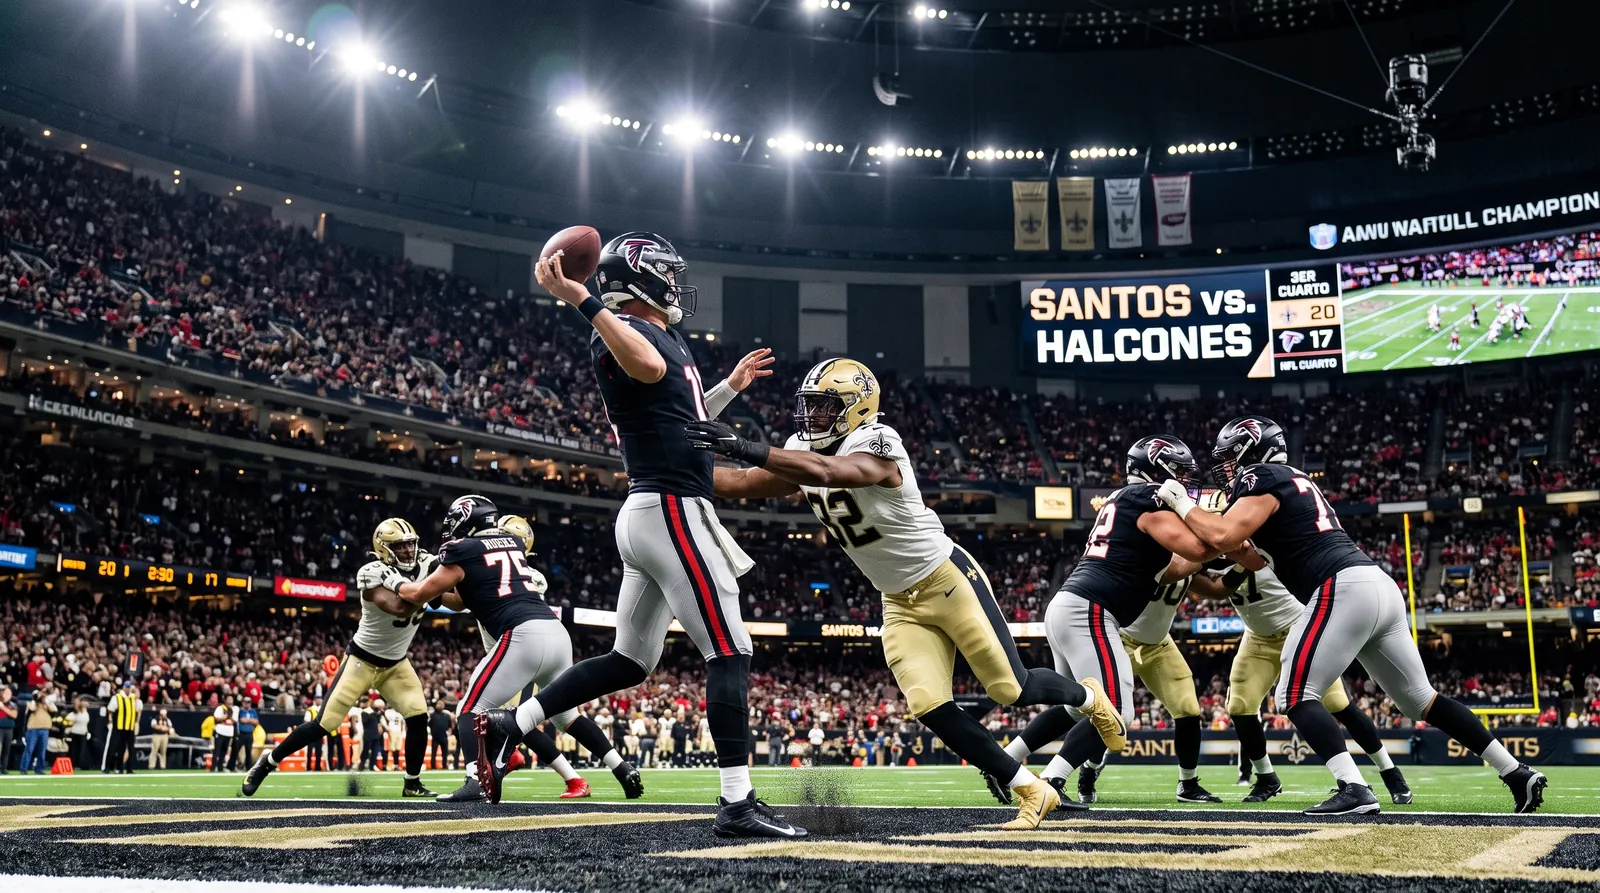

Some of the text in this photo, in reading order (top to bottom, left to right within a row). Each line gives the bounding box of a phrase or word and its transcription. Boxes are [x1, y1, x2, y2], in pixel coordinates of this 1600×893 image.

[1482, 191, 1600, 226] CHAMPION
[1290, 270, 1316, 283] 3ER
[1278, 282, 1330, 297] CUARTO
[1030, 284, 1192, 321] SANTOS
[1310, 304, 1336, 320] 20
[1037, 323, 1252, 363] HALCONES
[1309, 329, 1334, 349] 17
[1299, 357, 1338, 370] CUARTO
[98, 560, 117, 576] 20
[205, 573, 219, 587] 17
[483, 550, 538, 598] 75
[821, 625, 865, 637] SANTOS
[1121, 739, 1178, 757] SAINT
[59, 758, 71, 773] 10
